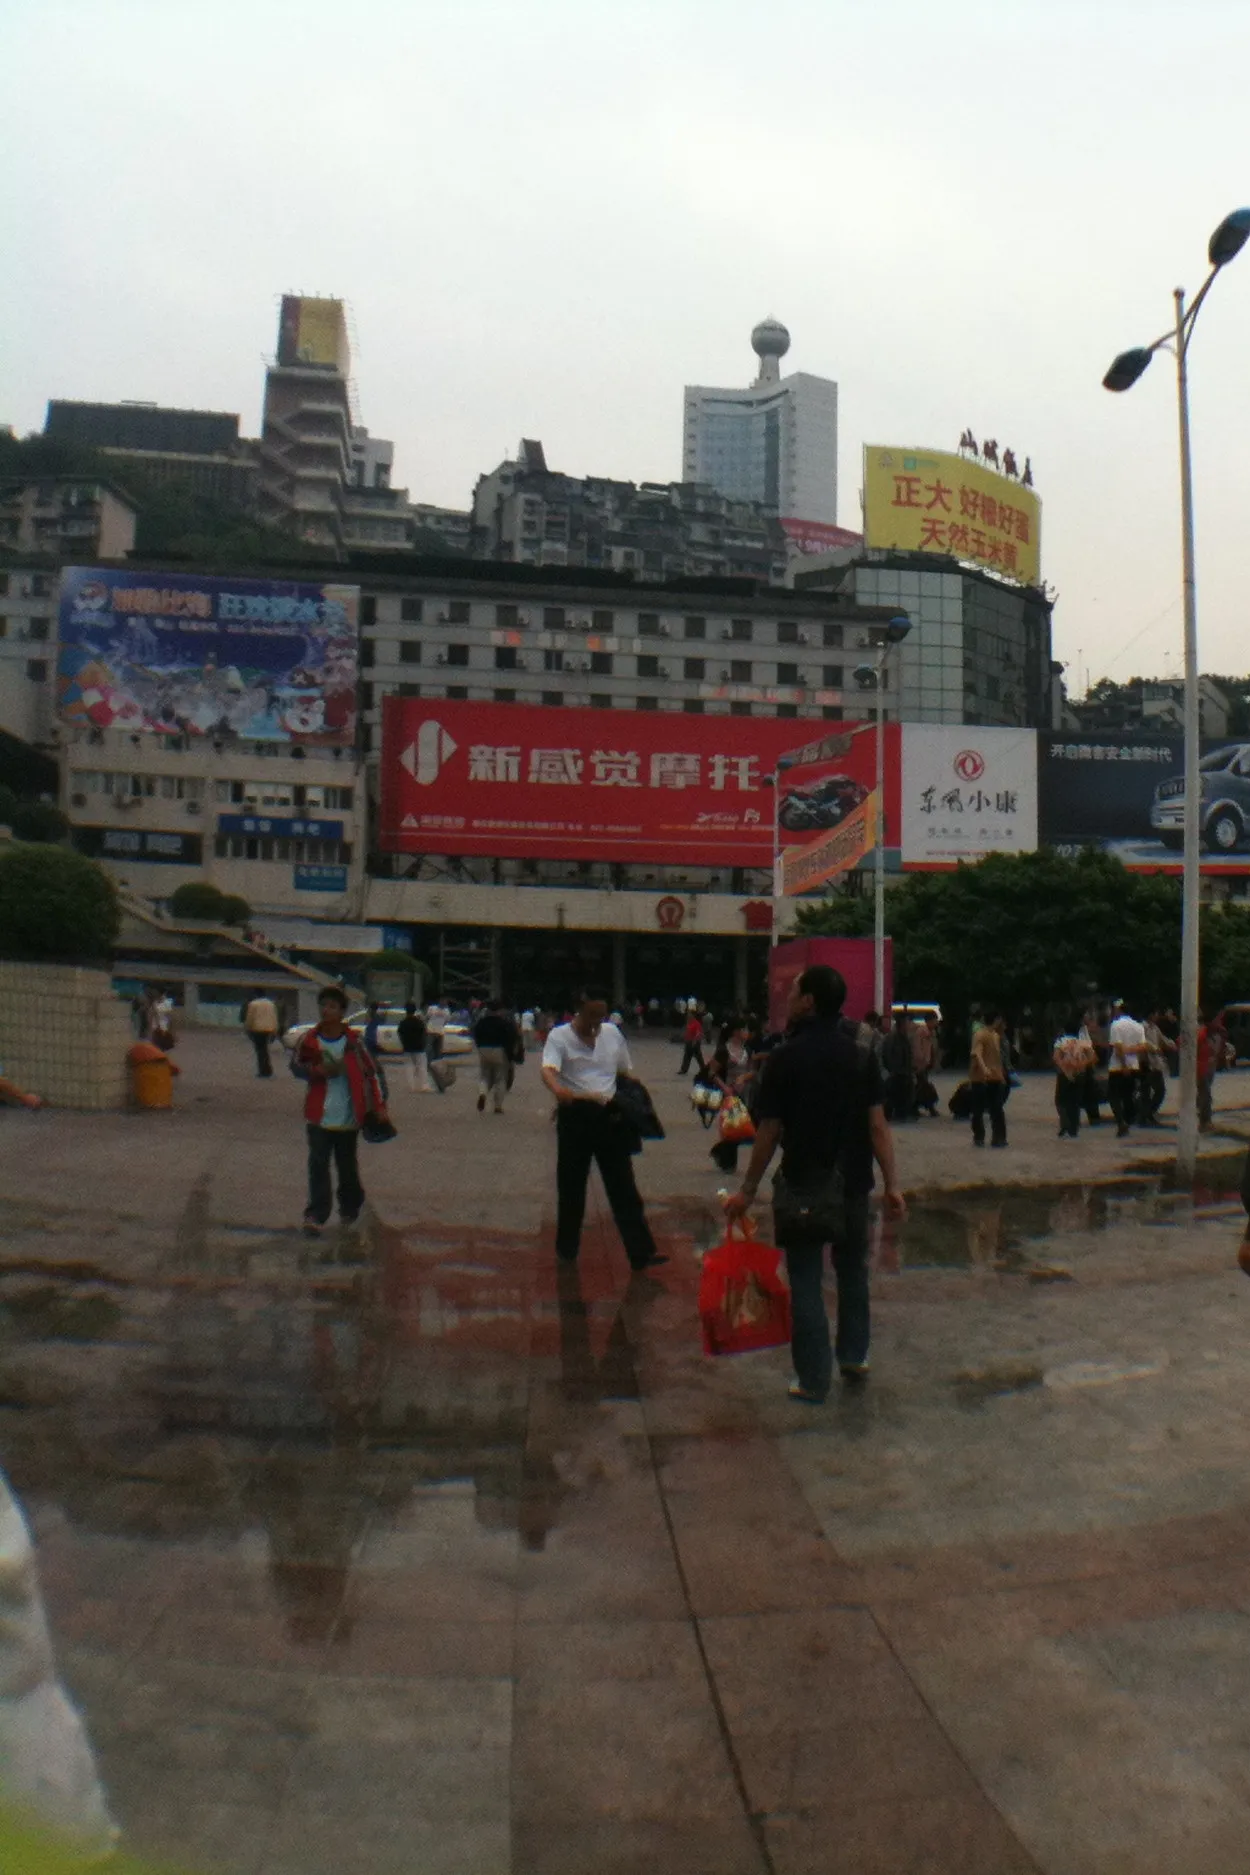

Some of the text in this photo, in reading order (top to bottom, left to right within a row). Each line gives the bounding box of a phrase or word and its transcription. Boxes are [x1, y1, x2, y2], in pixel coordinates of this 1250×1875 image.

[891, 475, 952, 513] 正大
[467, 744, 761, 792] 新感觉摩托
[920, 785, 1018, 814] 东风小康
